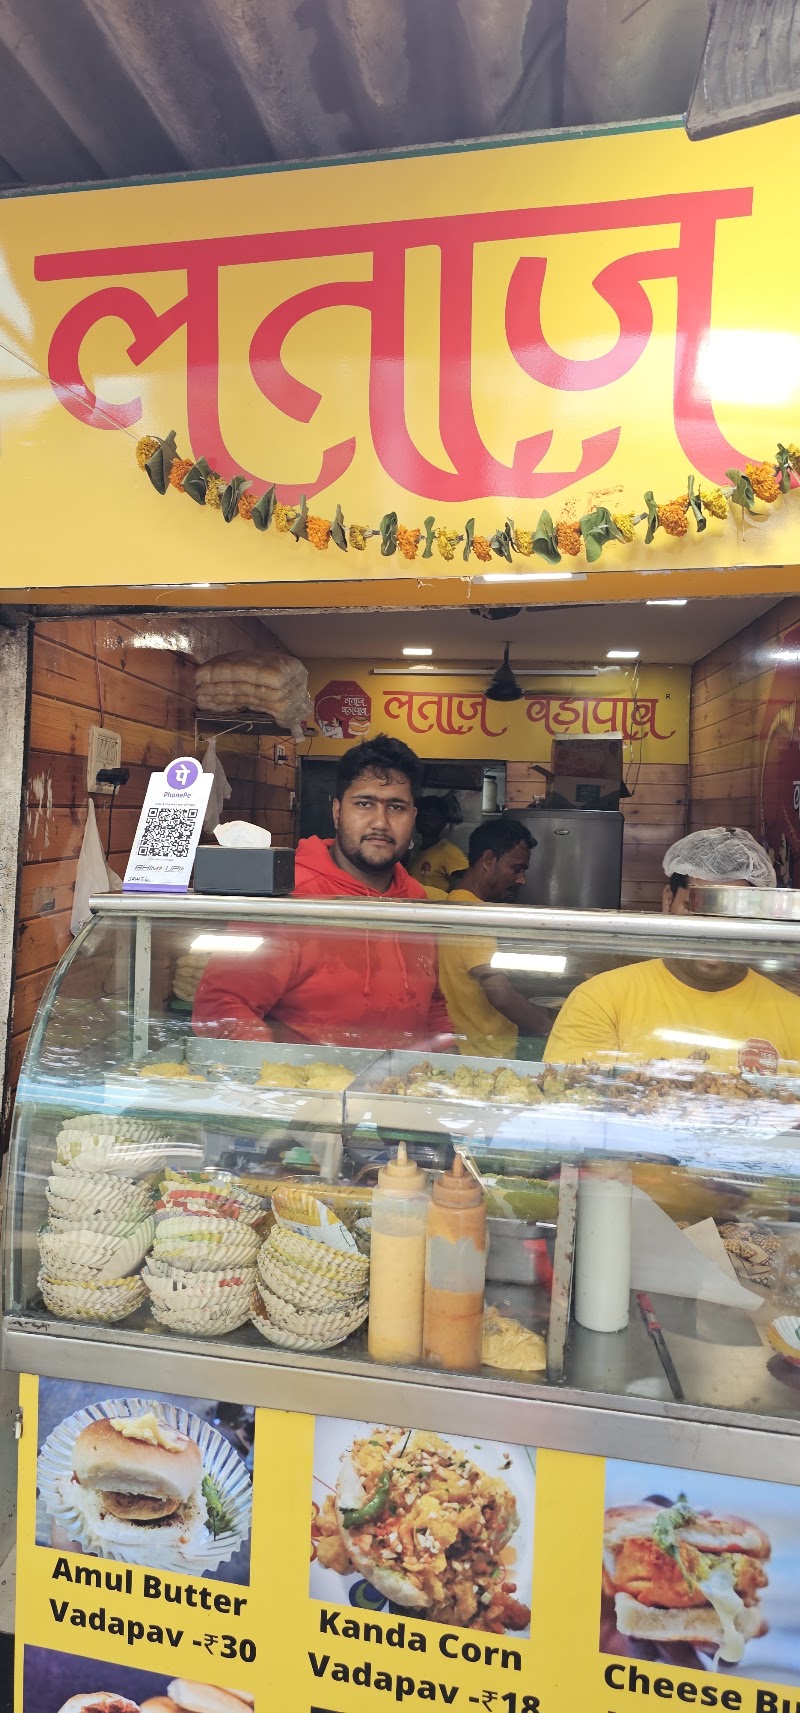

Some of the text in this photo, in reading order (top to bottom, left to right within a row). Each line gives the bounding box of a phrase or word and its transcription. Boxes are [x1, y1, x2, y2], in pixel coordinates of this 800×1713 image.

[163, 791, 192, 799] PhonePe
[175, 764, 191, 785] पे
[52, 1557, 247, 1616] Amul Butter
[49, 1598, 184, 1648] Vadapav
[319, 1609, 523, 1671] Kanda Corn
[307, 1652, 459, 1704] Vadapav
[604, 1663, 742, 1710] Cheese
